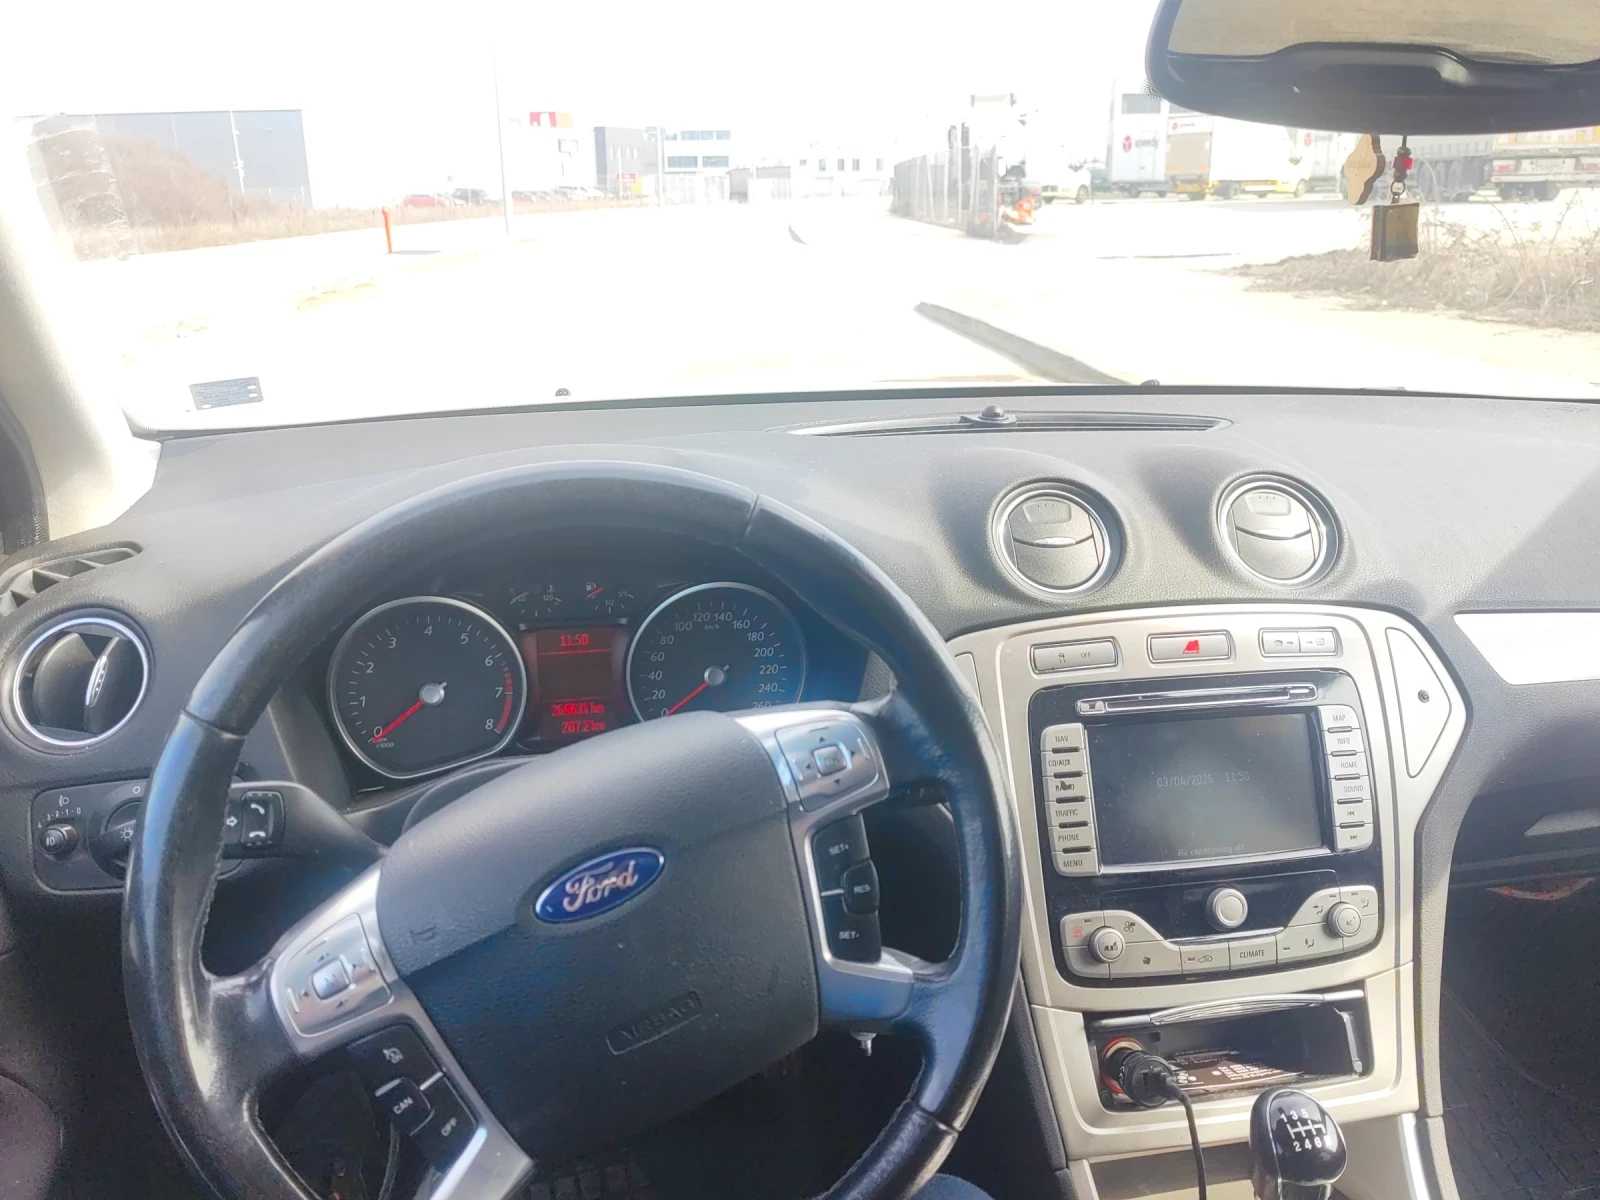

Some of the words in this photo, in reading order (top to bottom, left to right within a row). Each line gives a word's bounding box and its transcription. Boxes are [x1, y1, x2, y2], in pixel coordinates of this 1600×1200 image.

[692, 612, 710, 622] 120
[713, 612, 733, 622] 140
[673, 621, 693, 631] 100
[732, 619, 750, 630] 160
[424, 625, 433, 636] 4
[460, 633, 469, 644] 5
[560, 633, 589, 647] 11:50
[659, 635, 674, 645] 80
[746, 631, 765, 642] 180
[388, 637, 397, 648] 3
[650, 651, 665, 662] 60
[754, 647, 774, 657] 200
[1080, 651, 1091, 659] OFF
[484, 656, 493, 666] 6
[365, 662, 374, 673] 2
[759, 664, 779, 674] 220
[648, 670, 663, 681] 40
[495, 687, 503, 698] 7
[758, 683, 778, 693] 240
[652, 689, 666, 700] 20
[359, 696, 366, 706] 1
[590, 702, 605, 714] km
[1332, 714, 1346, 722] MAP
[485, 719, 493, 730] 8
[591, 720, 605, 731] km
[373, 725, 383, 738] 0
[1055, 735, 1069, 743] NAV
[1337, 737, 1351, 745] INFO
[1048, 759, 1072, 767] CD/AUX
[1340, 761, 1359, 769] HOME
[1225, 770, 1250, 784] 11:50
[1343, 784, 1364, 793] SOUND
[46, 813, 51, 821] 3
[55, 810, 60, 818] 2
[76, 807, 82, 815] 0
[1055, 808, 1079, 817] TRAFFIC
[1058, 833, 1080, 842] PHONE
[1063, 858, 1084, 868] MENU
[563, 859, 639, 912] Ford
[1239, 948, 1265, 959] CLIMATE
[393, 1096, 414, 1115] CAN
[1280, 1113, 1287, 1123] 1
[1290, 1110, 1299, 1121] 3
[1300, 1108, 1310, 1119] 5
[440, 1117, 458, 1137] OFF
[1293, 1141, 1302, 1152] 2
[1304, 1139, 1313, 1150] 4
[1314, 1136, 1323, 1148] 6
